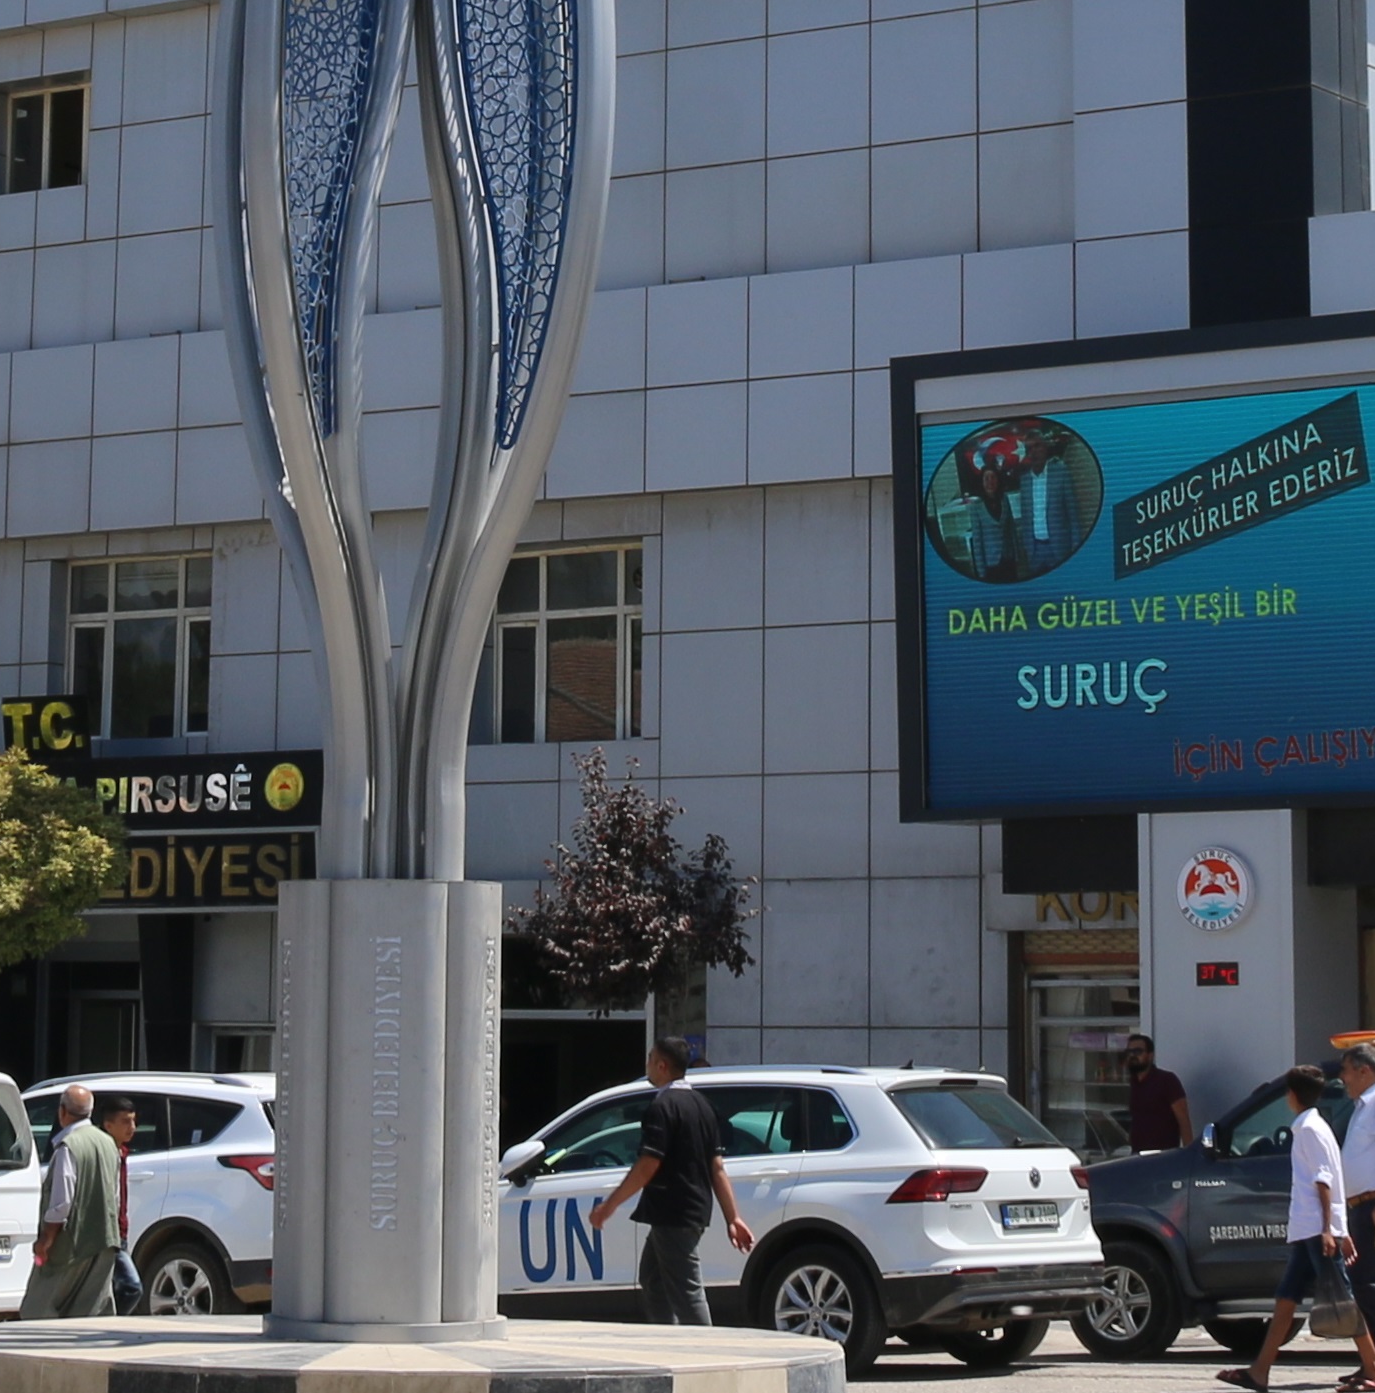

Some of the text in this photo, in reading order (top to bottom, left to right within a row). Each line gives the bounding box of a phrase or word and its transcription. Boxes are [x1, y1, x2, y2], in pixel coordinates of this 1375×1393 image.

[1134, 421, 1324, 526] SURUÇ HALKINA
[1121, 446, 1360, 568] TEŞEKKÜRLER EDERİZ
[948, 585, 1299, 636] DAHA GÜZEL VE YEŞİL BİR
[1016, 656, 1169, 715] SURUÇ
[2, 700, 85, 750] T.C.
[1172, 734, 1244, 783] İÇİN
[101, 833, 300, 899] DİYESİ
[1193, 850, 1233, 865] SURUÇ
[1181, 901, 1245, 931] BELEDİYESİ
[1200, 965, 1216, 980] 37
[369, 934, 405, 1232] SURUÇ BELEDİYESİ
[520, 1197, 604, 1283] UN
[1266, 1223, 1289, 1239] PIRS
